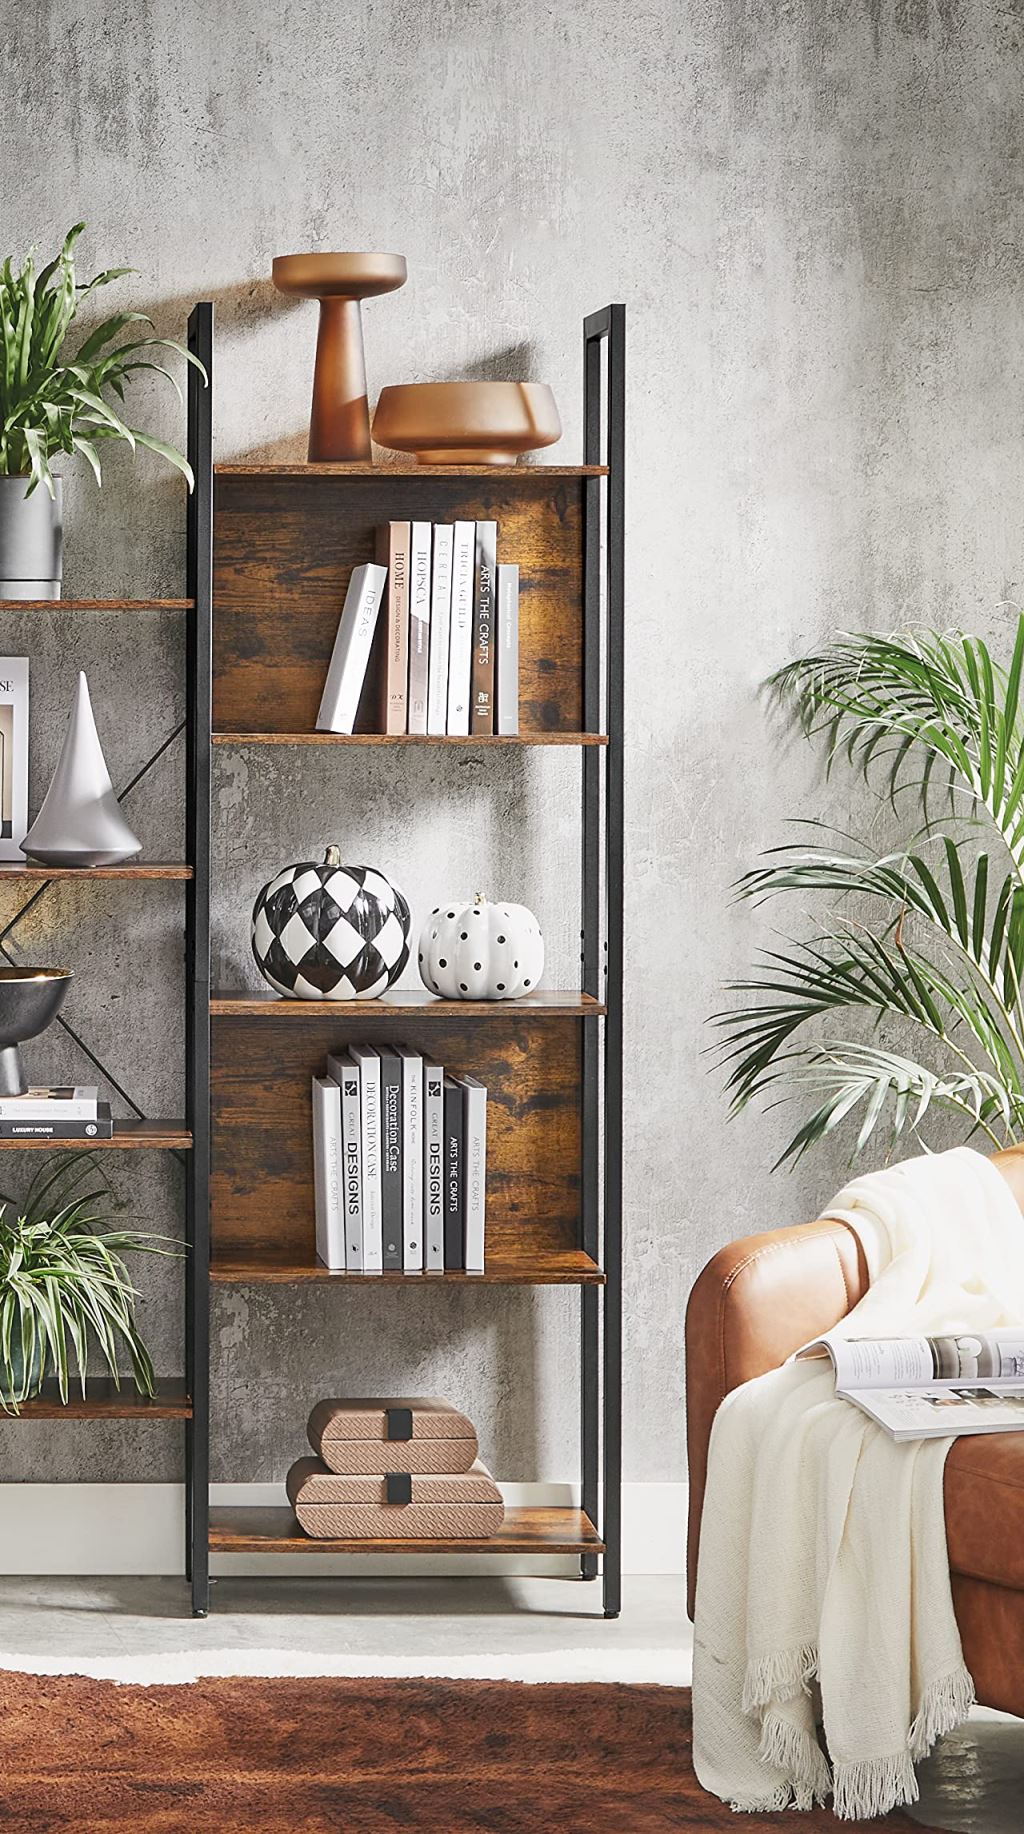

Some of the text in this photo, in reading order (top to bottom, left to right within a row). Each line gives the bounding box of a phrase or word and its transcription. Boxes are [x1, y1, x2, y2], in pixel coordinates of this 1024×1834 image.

[394, 552, 405, 590] HOME
[416, 552, 427, 604] HOPSCA
[438, 540, 448, 601] CEREAL
[358, 590, 376, 638] IDEAS
[478, 565, 491, 664] ARTS THE CRAFTS
[348, 1112, 360, 1215] GREAT DESIGNS
[366, 1082, 377, 1181] DECORATION CASE
[388, 1085, 400, 1172] Decoration Case
[472, 1136, 480, 1158] ARTS
[328, 1136, 339, 1212] ARTS THE CRAFTS
[430, 1143, 440, 1216] DESIGNS
[448, 1136, 458, 1212] ARTS THE CRAFTS
[472, 1161, 480, 1177] THE
